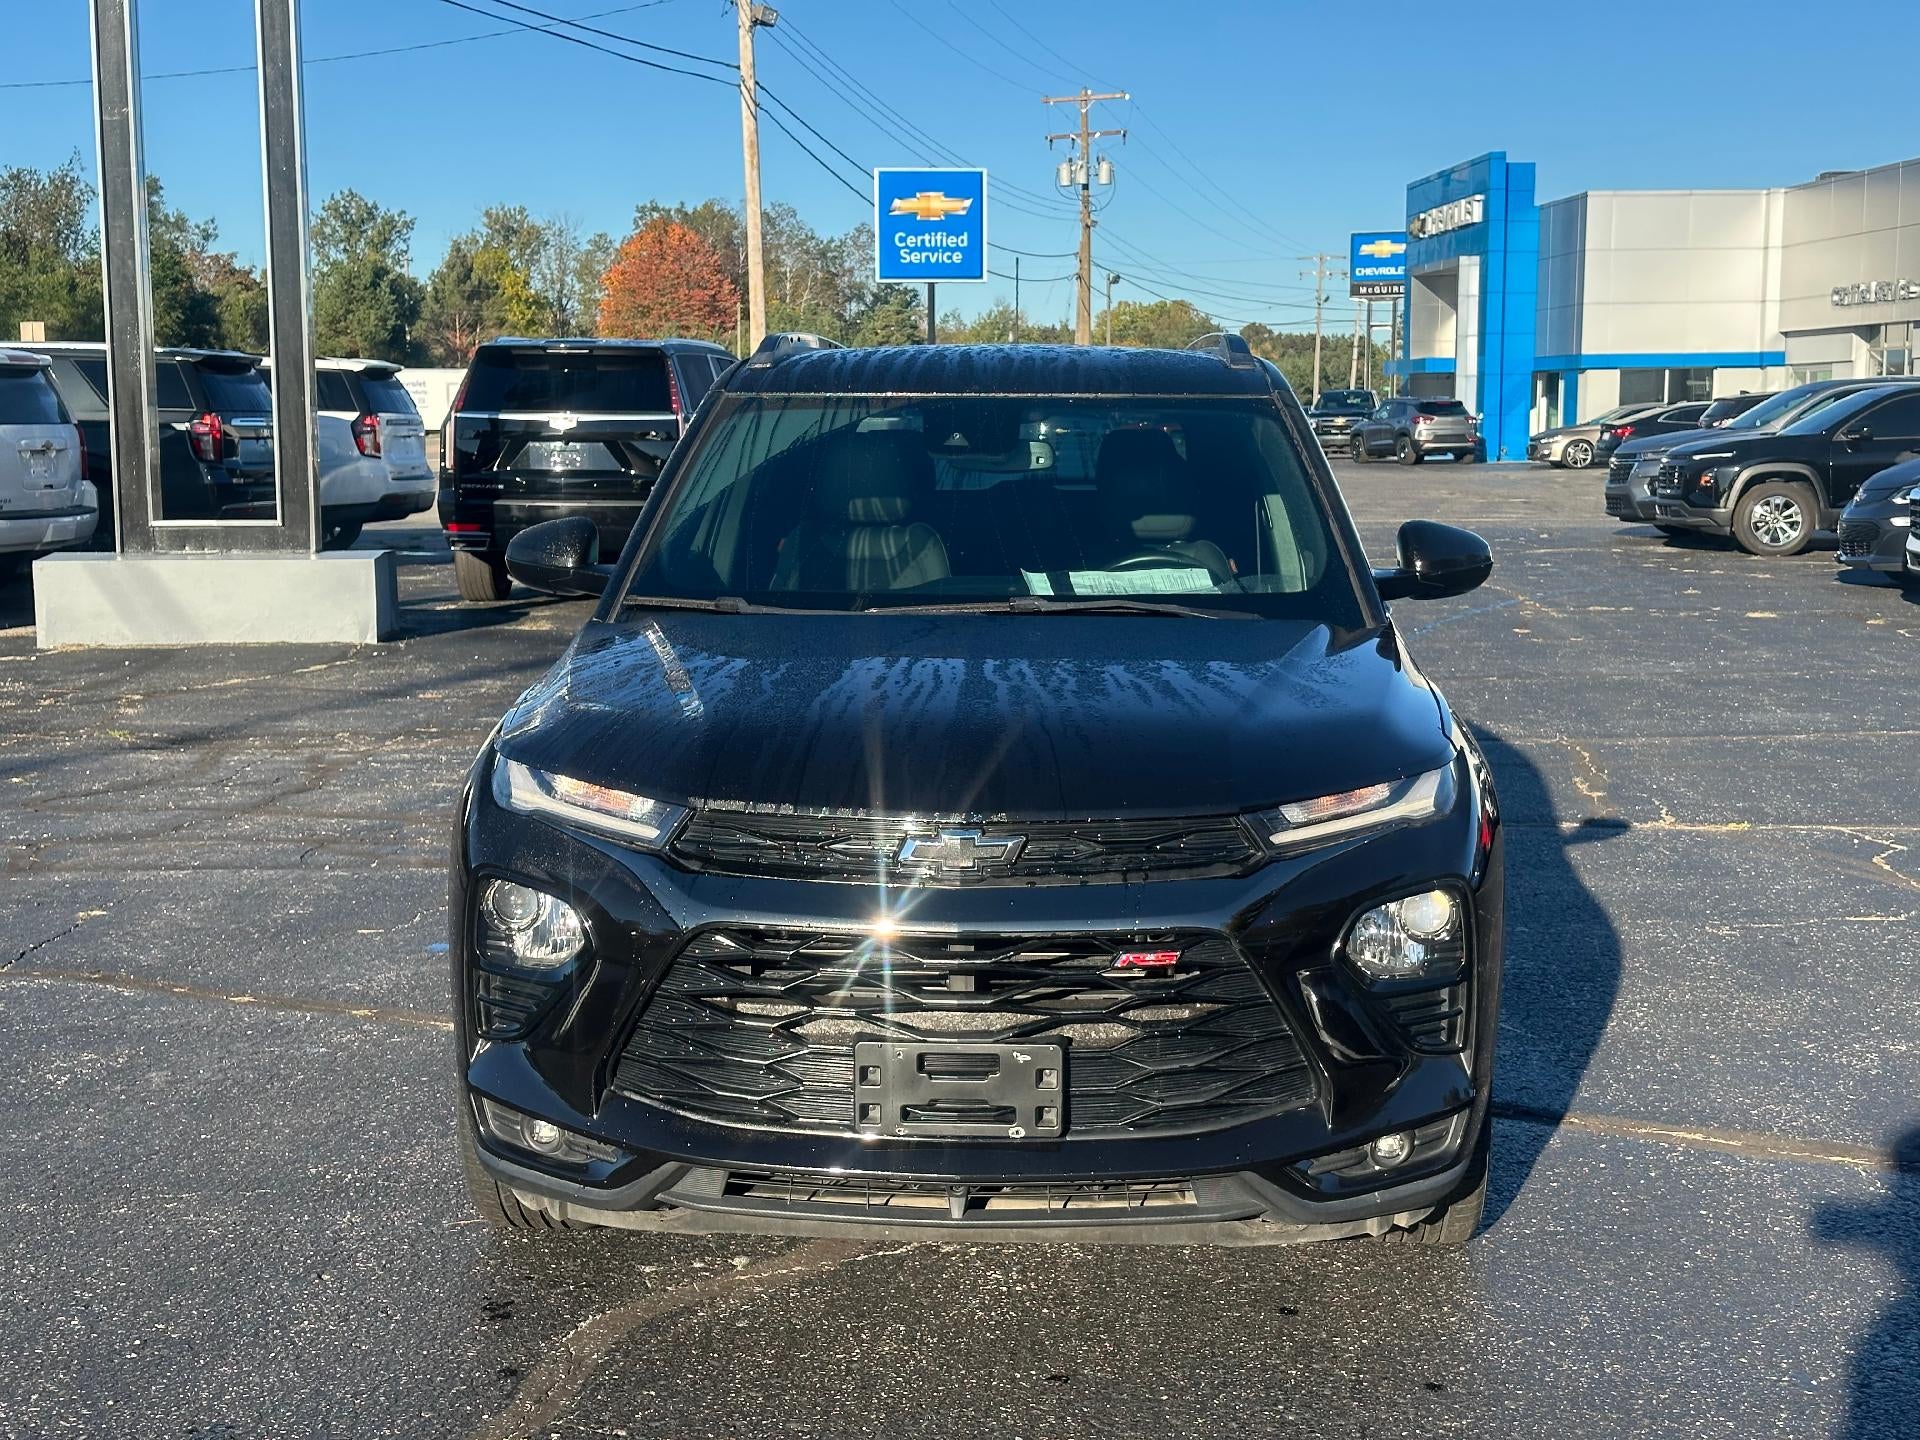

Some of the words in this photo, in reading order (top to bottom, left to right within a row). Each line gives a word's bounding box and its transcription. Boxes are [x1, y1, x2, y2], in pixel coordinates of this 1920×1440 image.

[894, 231, 968, 248] Certified
[899, 248, 963, 264] Service
[1355, 266, 1406, 276] CHEVROLE
[1359, 285, 1406, 294] McGUIRE
